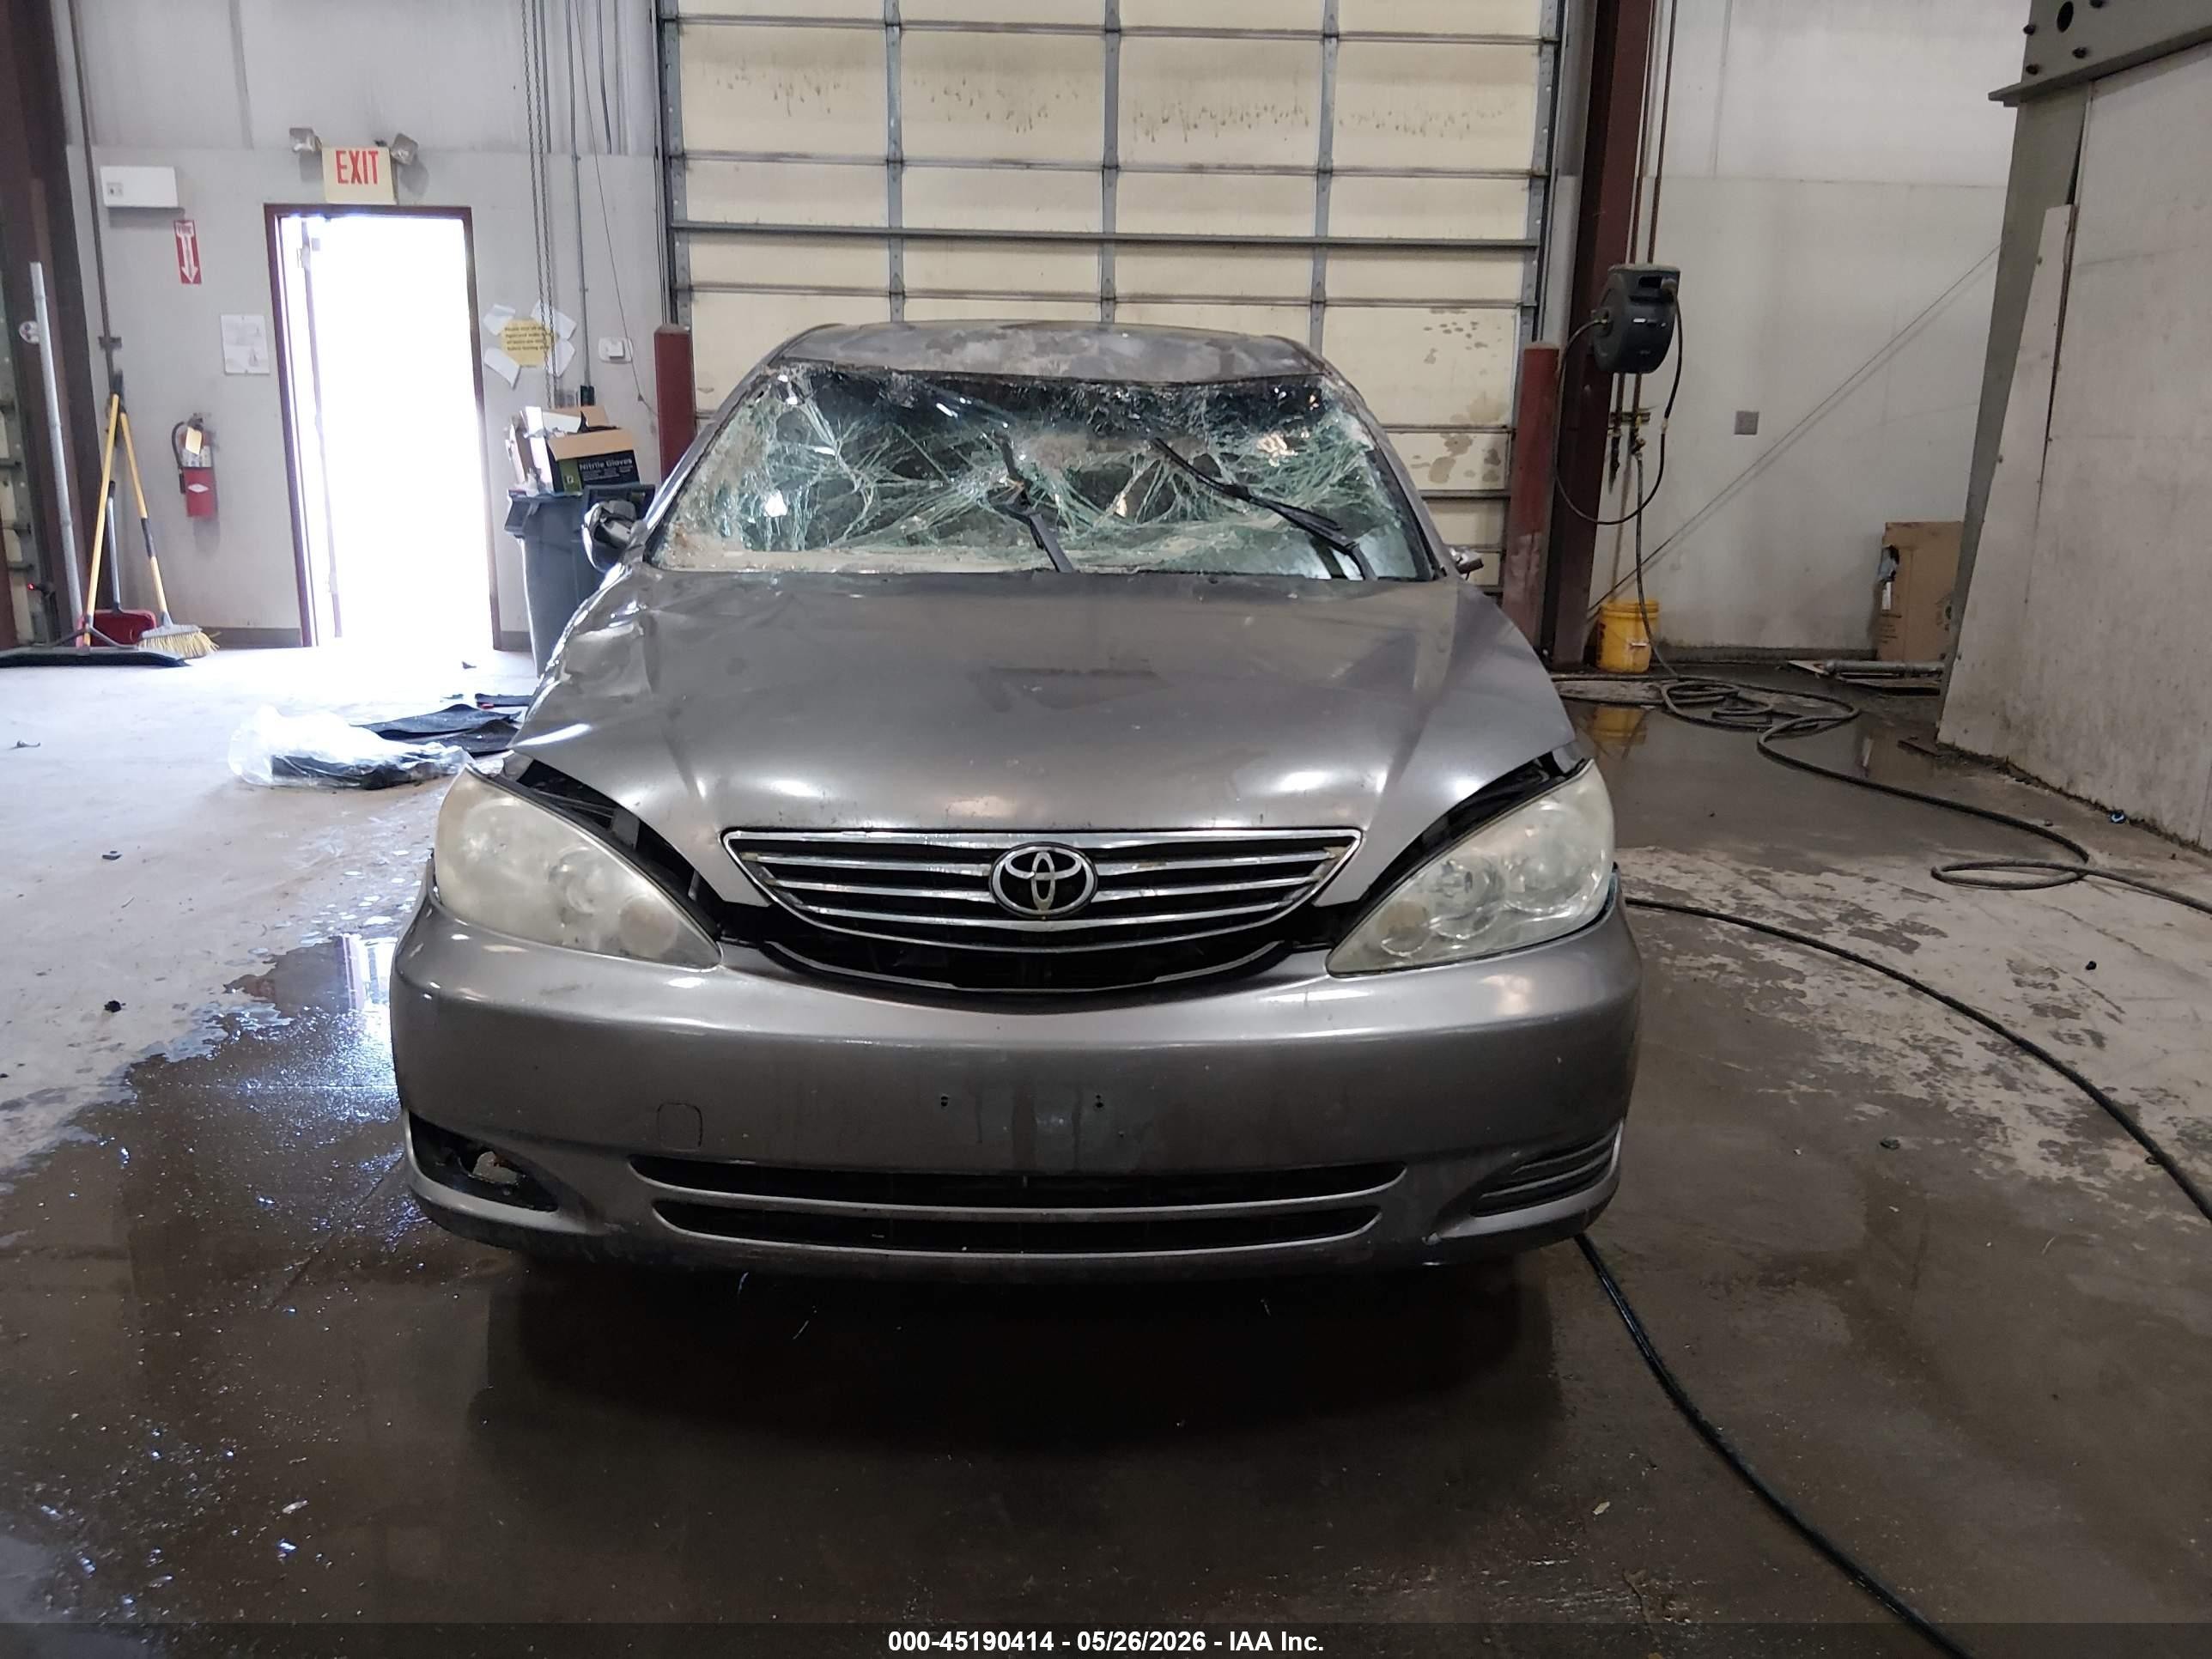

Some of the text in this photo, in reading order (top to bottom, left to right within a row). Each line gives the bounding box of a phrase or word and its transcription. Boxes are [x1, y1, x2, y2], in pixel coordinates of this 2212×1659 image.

[336, 150, 378, 184] EXIT
[580, 459, 632, 471] Nitrile Gloves
